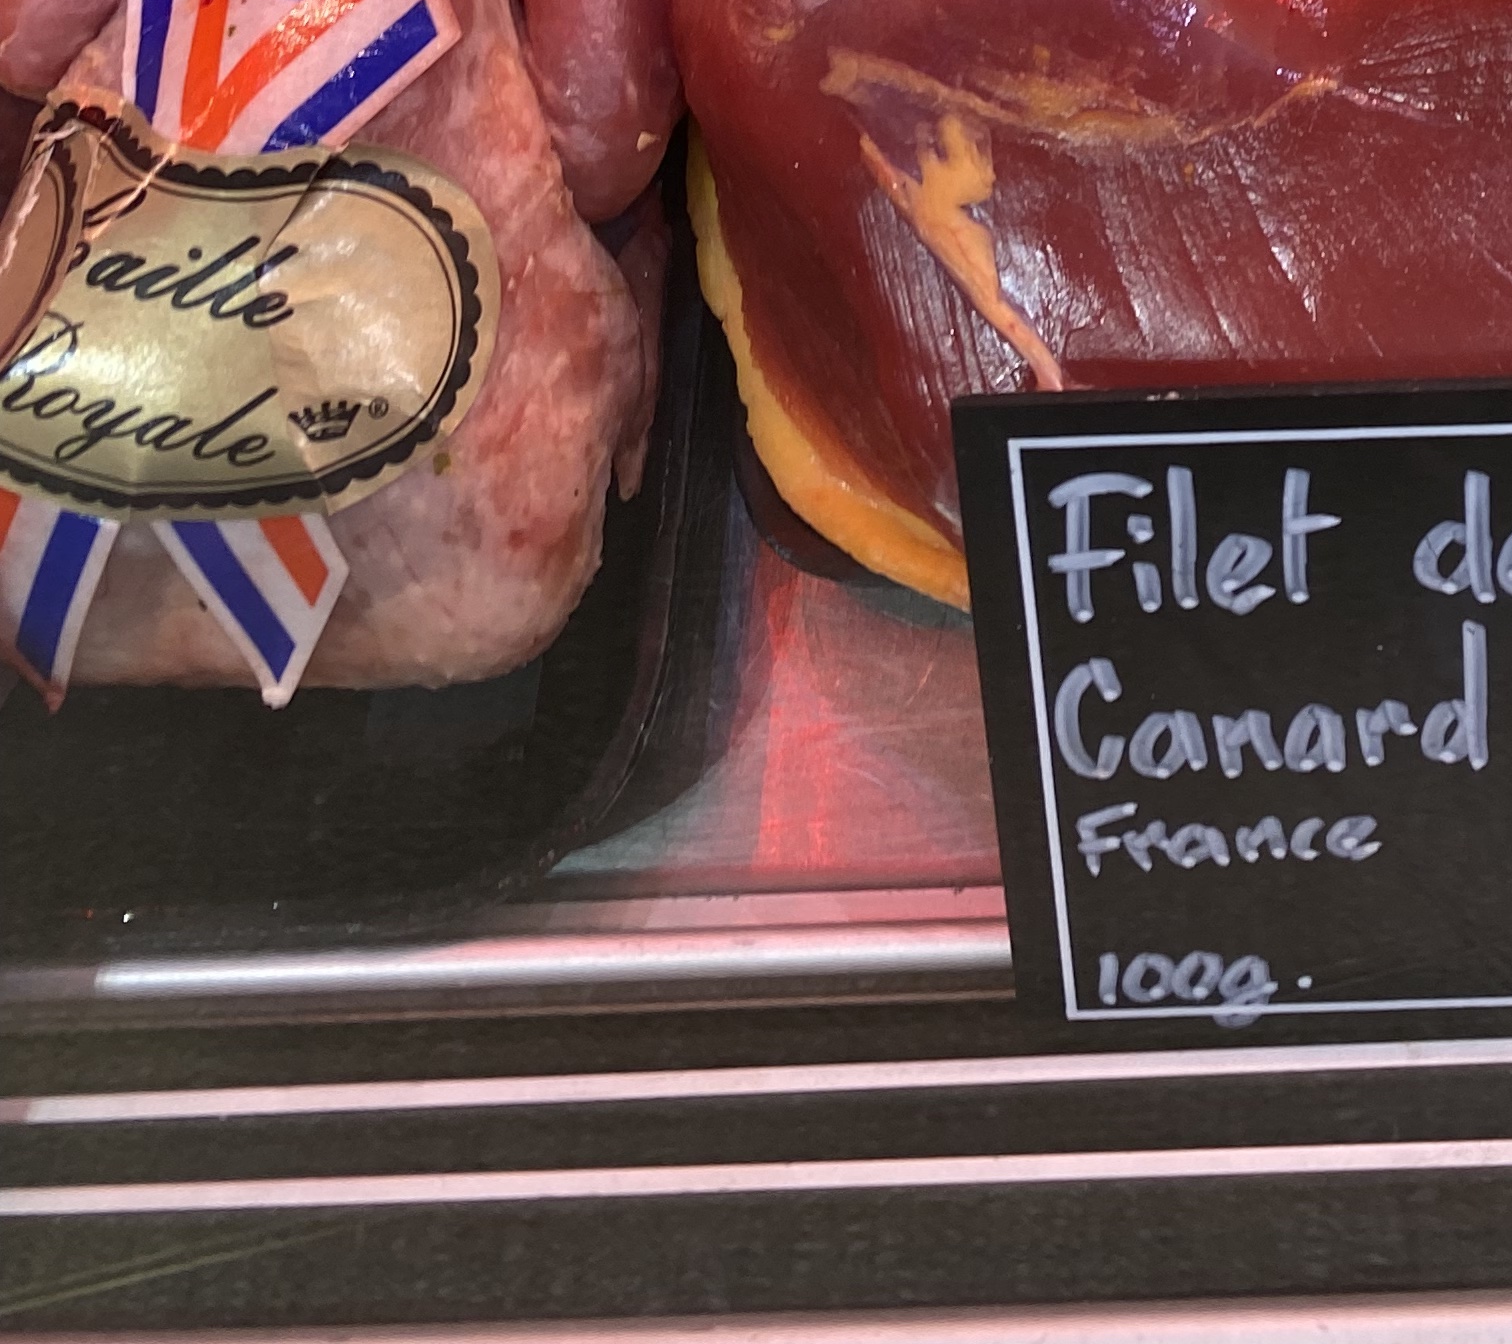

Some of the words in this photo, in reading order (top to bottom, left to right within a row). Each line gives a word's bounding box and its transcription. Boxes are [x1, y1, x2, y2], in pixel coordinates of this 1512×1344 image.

[1047, 465, 1342, 624] Filet
[1055, 618, 1489, 780] Canard
[1075, 801, 1383, 878] France
